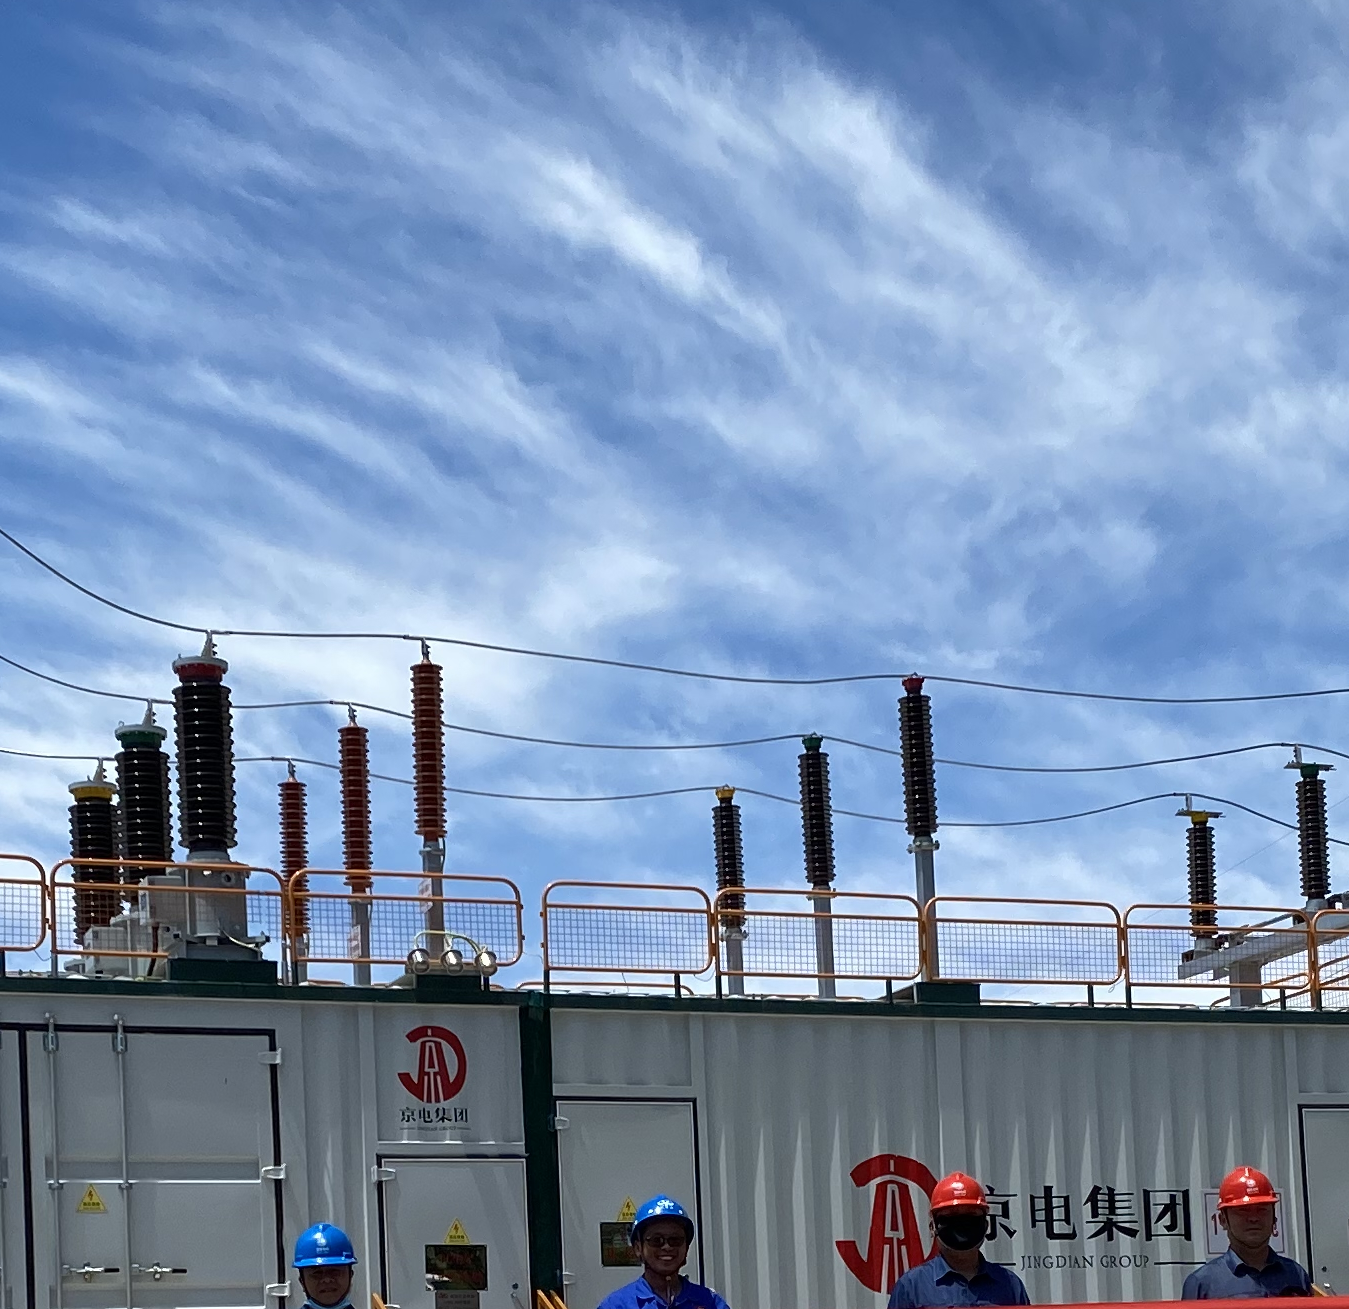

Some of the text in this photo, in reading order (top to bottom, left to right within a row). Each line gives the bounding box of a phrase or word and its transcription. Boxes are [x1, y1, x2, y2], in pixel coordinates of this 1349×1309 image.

[399, 1106, 469, 1123] 京电集团
[1021, 1254, 1149, 1269] JINGDIAN GROUP
